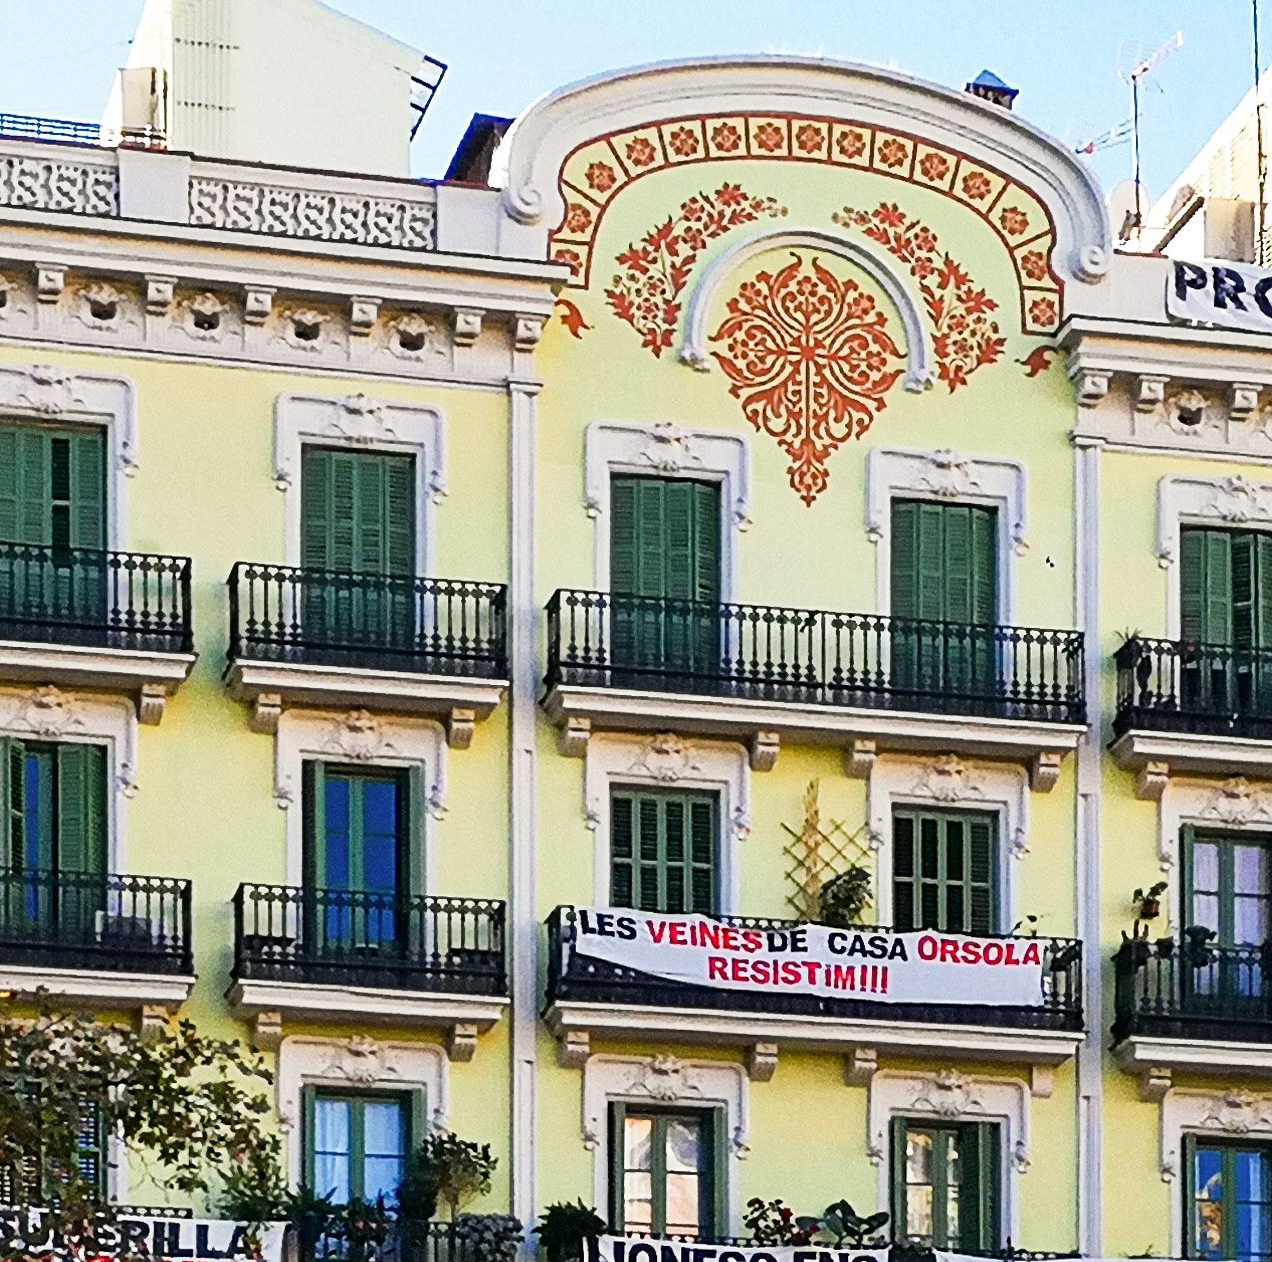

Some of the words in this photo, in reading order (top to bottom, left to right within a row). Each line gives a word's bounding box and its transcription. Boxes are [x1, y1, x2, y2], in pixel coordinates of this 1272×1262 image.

[581, 909, 637, 940] LES
[768, 929, 809, 955] DE
[827, 932, 908, 962] CASA
[917, 934, 1041, 966] ORSOLA
